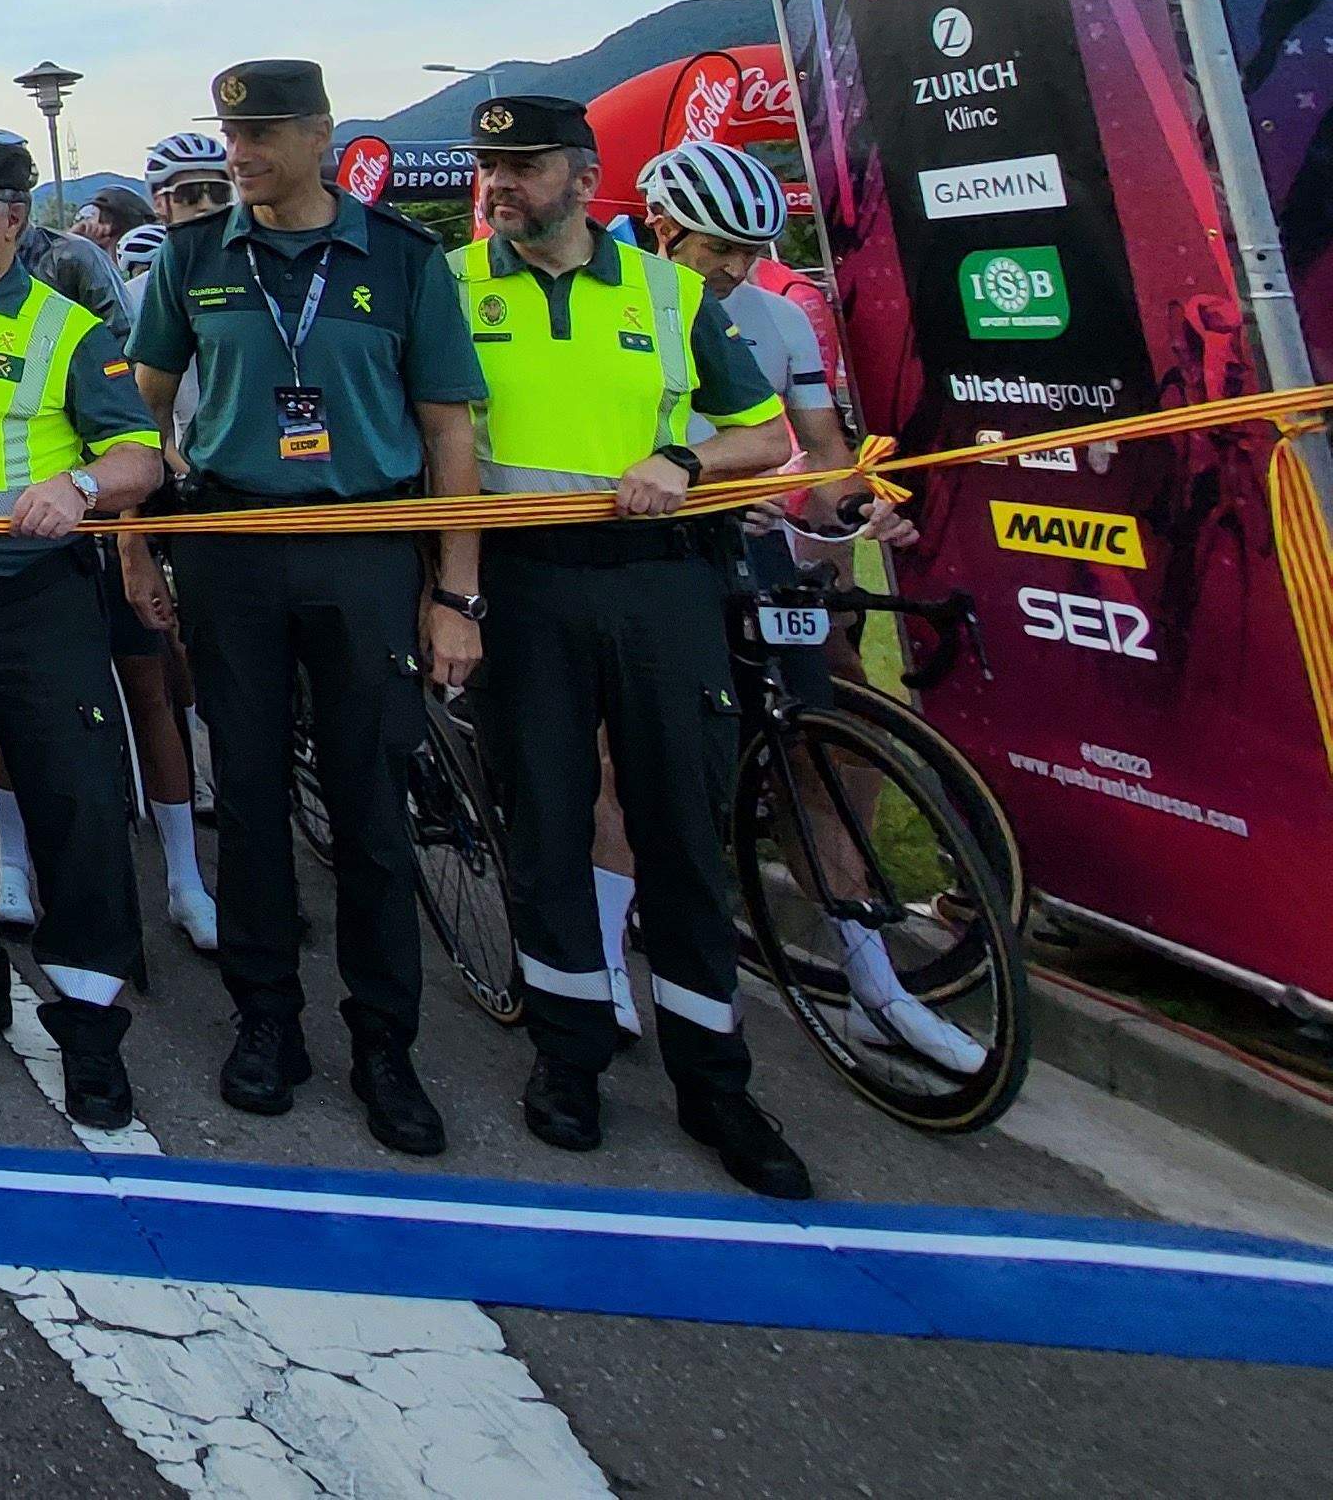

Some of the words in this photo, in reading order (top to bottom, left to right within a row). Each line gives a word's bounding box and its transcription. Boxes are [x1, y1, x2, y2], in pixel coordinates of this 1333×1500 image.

[912, 60, 1019, 105] ZURICH
[944, 107, 998, 132] Klinc
[934, 170, 1048, 204] GARMIN
[188, 287, 223, 297] GUARDIA
[225, 286, 246, 294] CIVIL
[950, 374, 1115, 413] bilsteingroup
[290, 438, 319, 451] CECOP
[1005, 512, 1129, 556] MAVIC
[773, 611, 816, 636] 165
